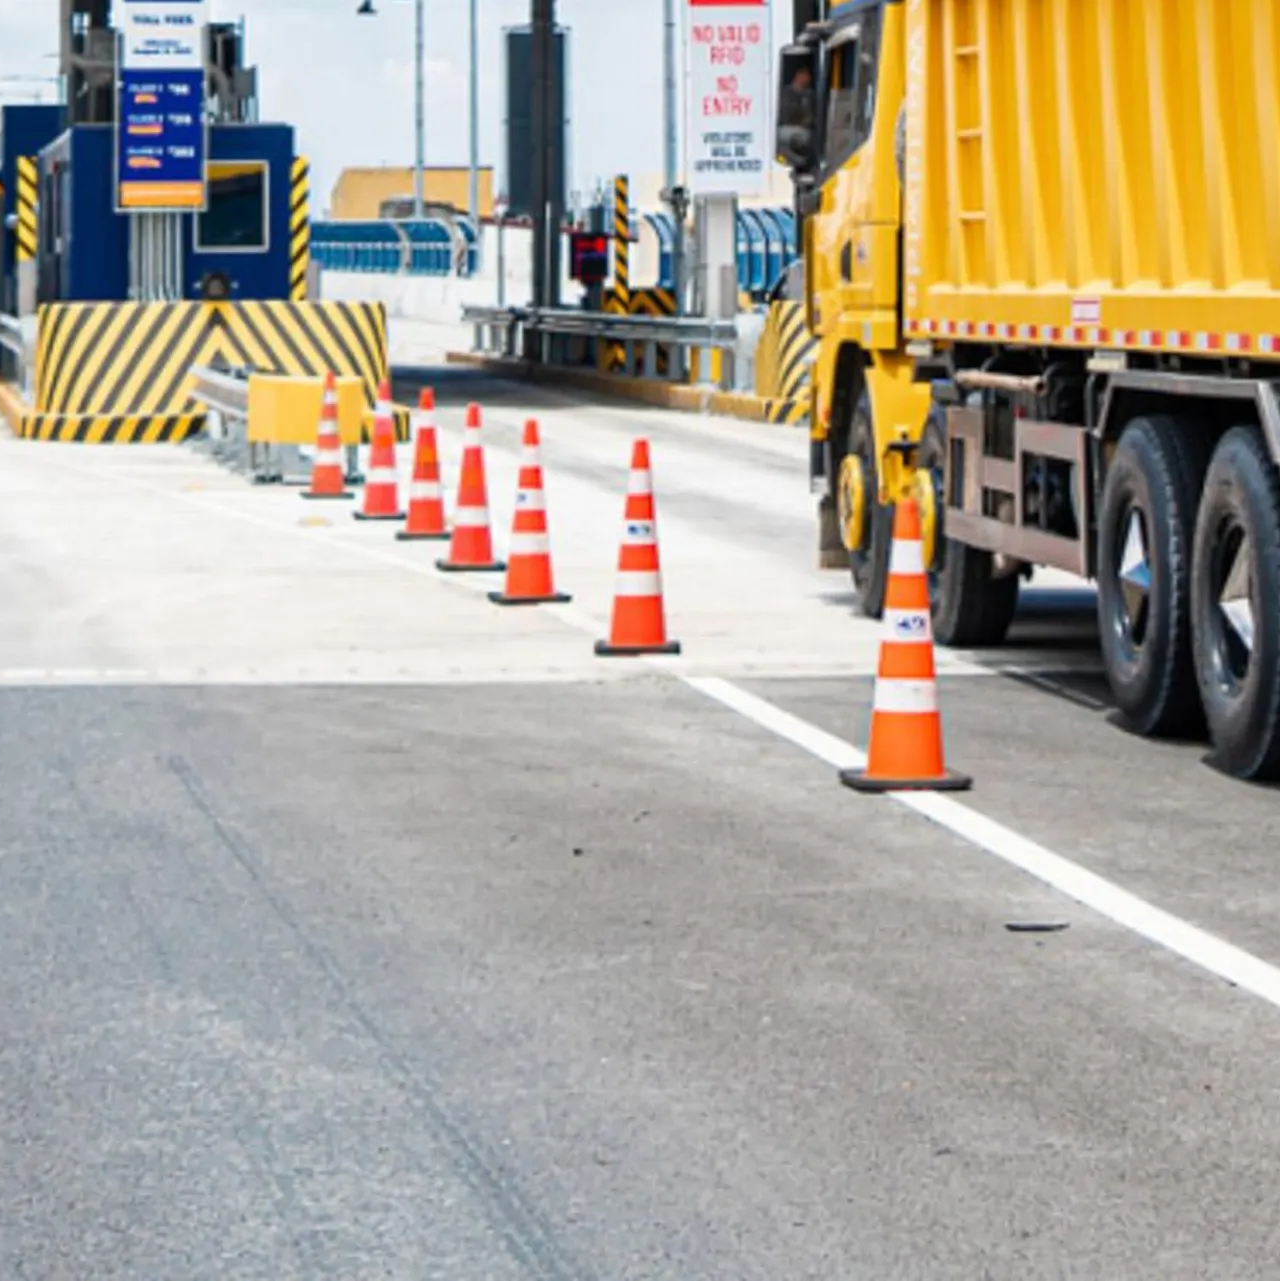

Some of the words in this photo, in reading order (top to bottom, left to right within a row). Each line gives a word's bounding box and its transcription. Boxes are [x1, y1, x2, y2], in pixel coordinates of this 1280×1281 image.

[692, 25, 714, 43] NO
[717, 24, 761, 43] VALID
[710, 46, 745, 65] RFID
[716, 74, 738, 92] NO
[702, 95, 752, 116] ENTRY
